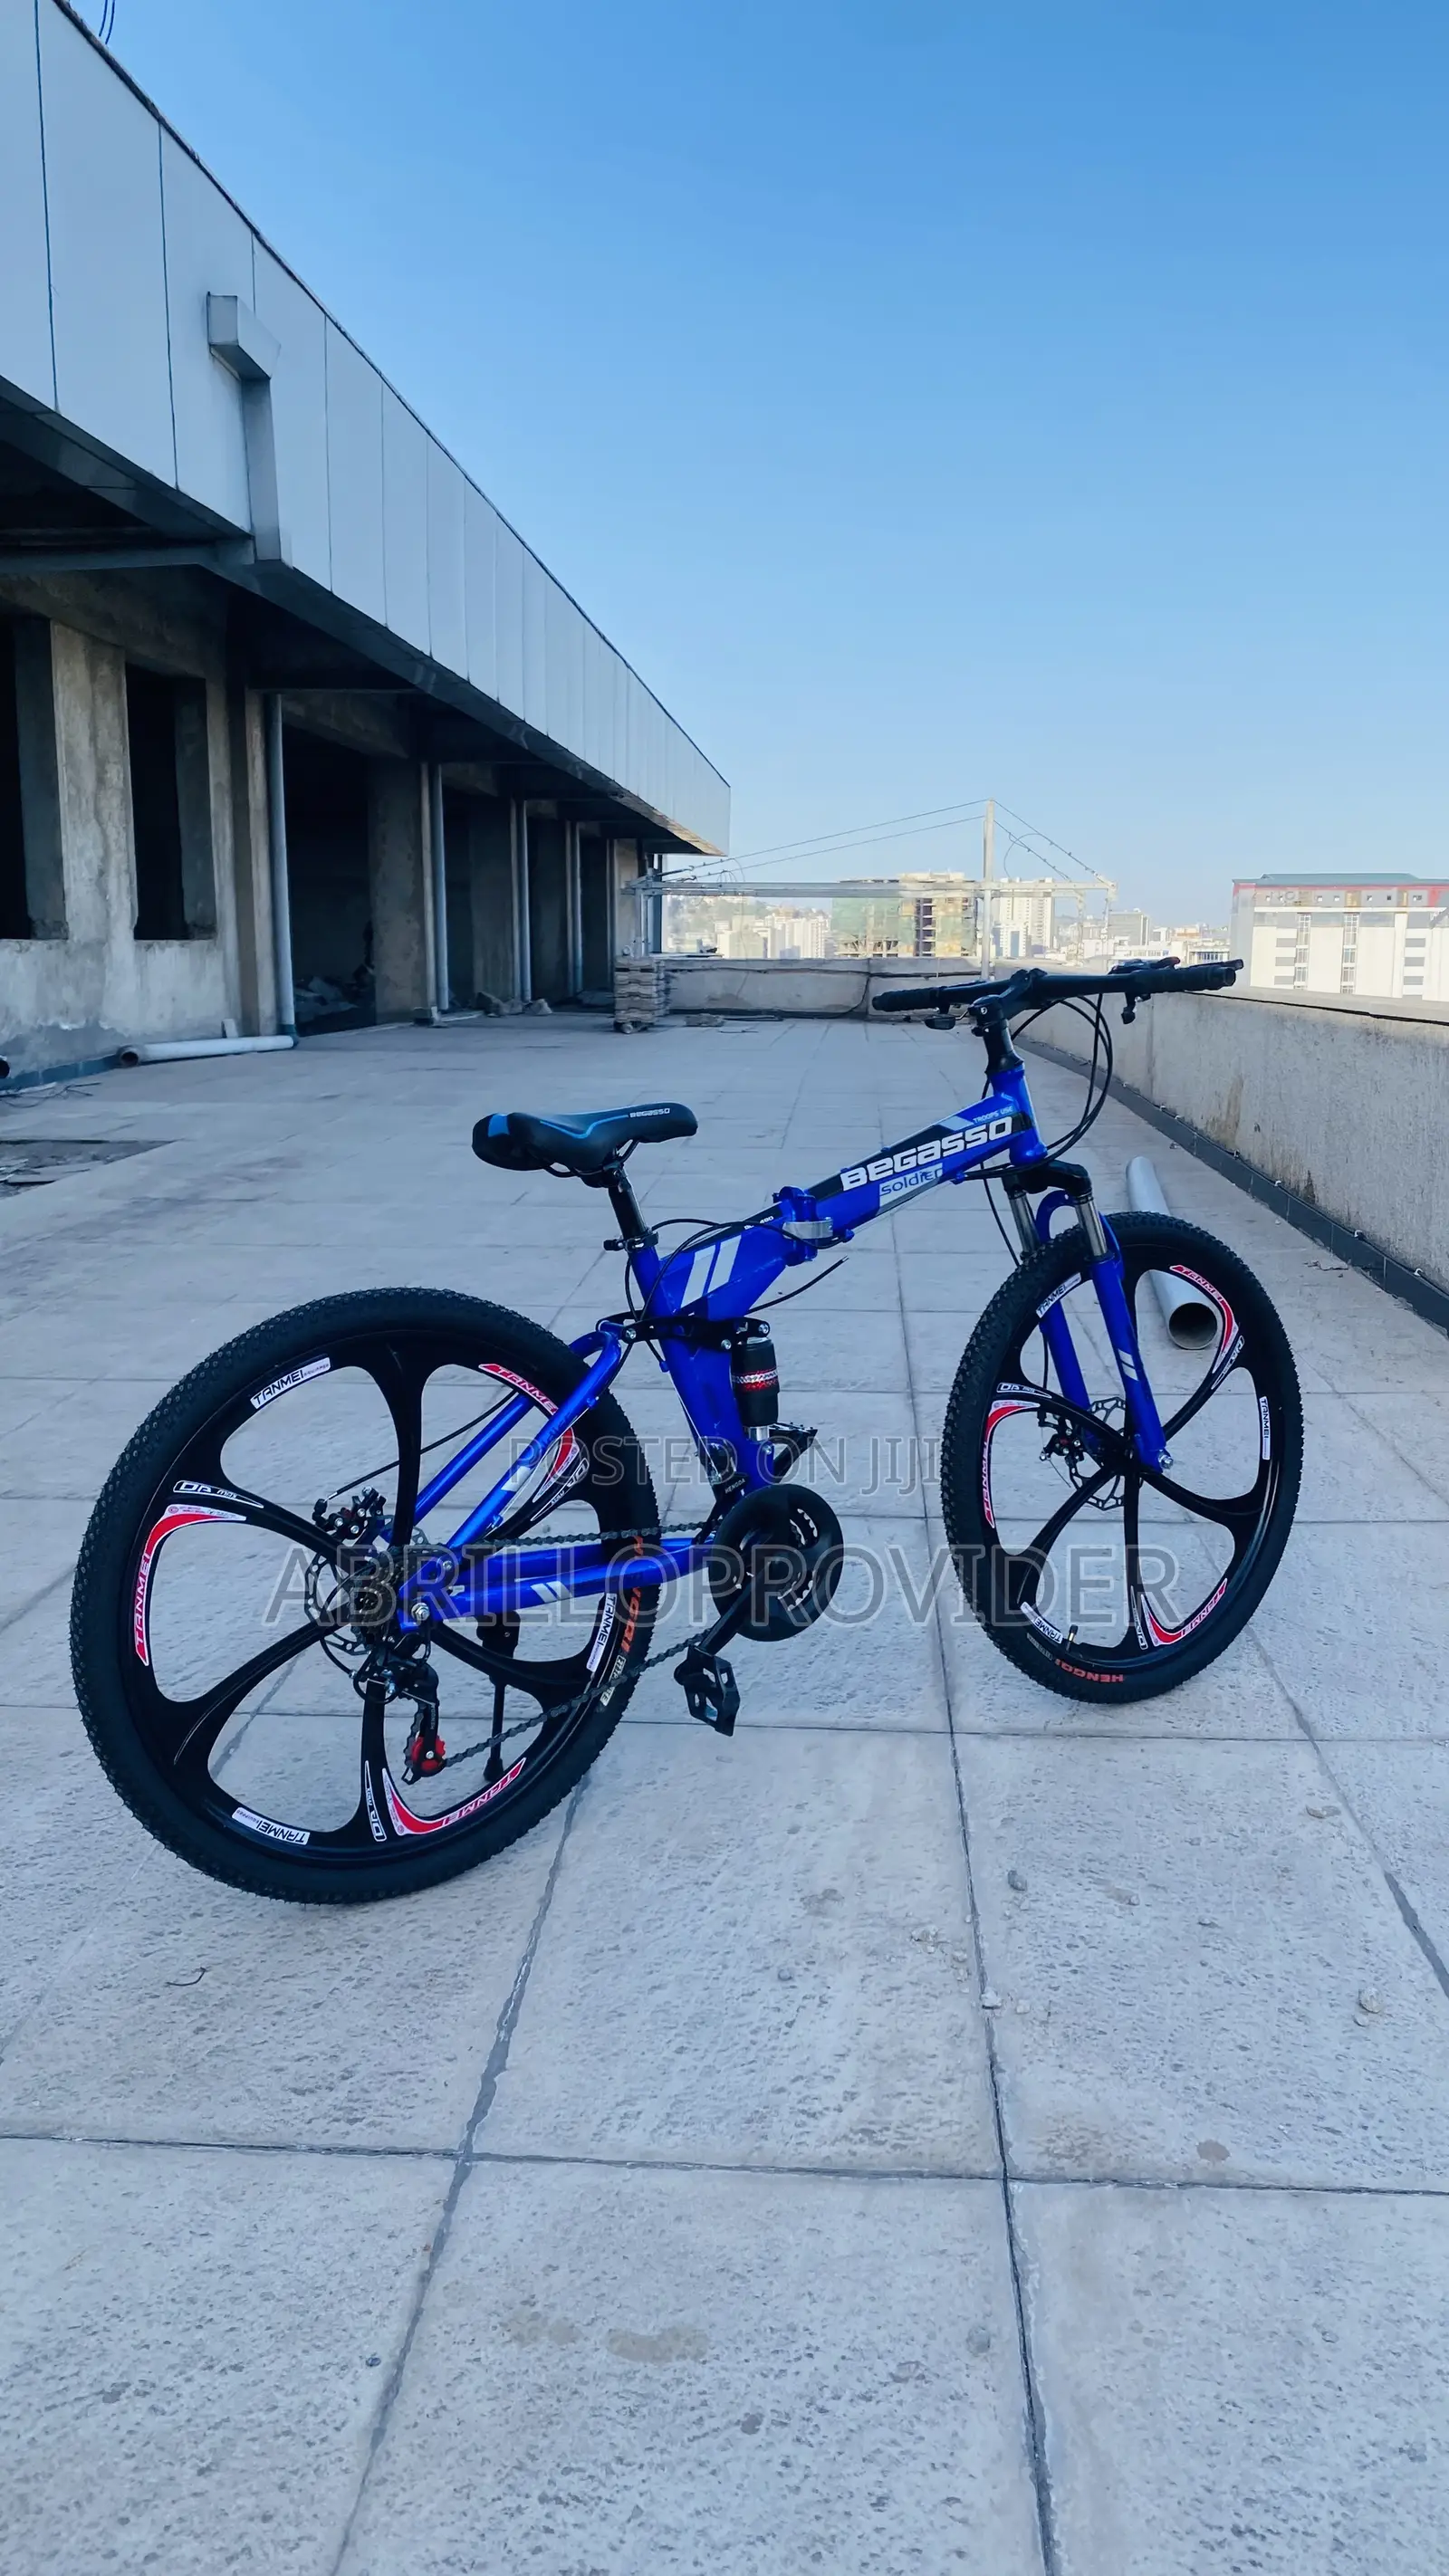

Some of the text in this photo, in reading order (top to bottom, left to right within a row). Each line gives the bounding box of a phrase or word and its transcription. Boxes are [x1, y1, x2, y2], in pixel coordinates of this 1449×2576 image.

[973, 1106, 1014, 1124] TROOPS USE
[1038, 1284, 1067, 1315] TANMEI
[253, 1370, 304, 1405] TANMEI
[497, 1365, 560, 1415] TANME
[1261, 1398, 1270, 1439] TANMEI
[135, 1553, 150, 1646] TANMEI
[598, 1594, 617, 1647] TANMEI
[1035, 1617, 1063, 1642] TANME
[442, 1775, 514, 1827] TANMEI
[255, 1820, 306, 1843] TANMEI
